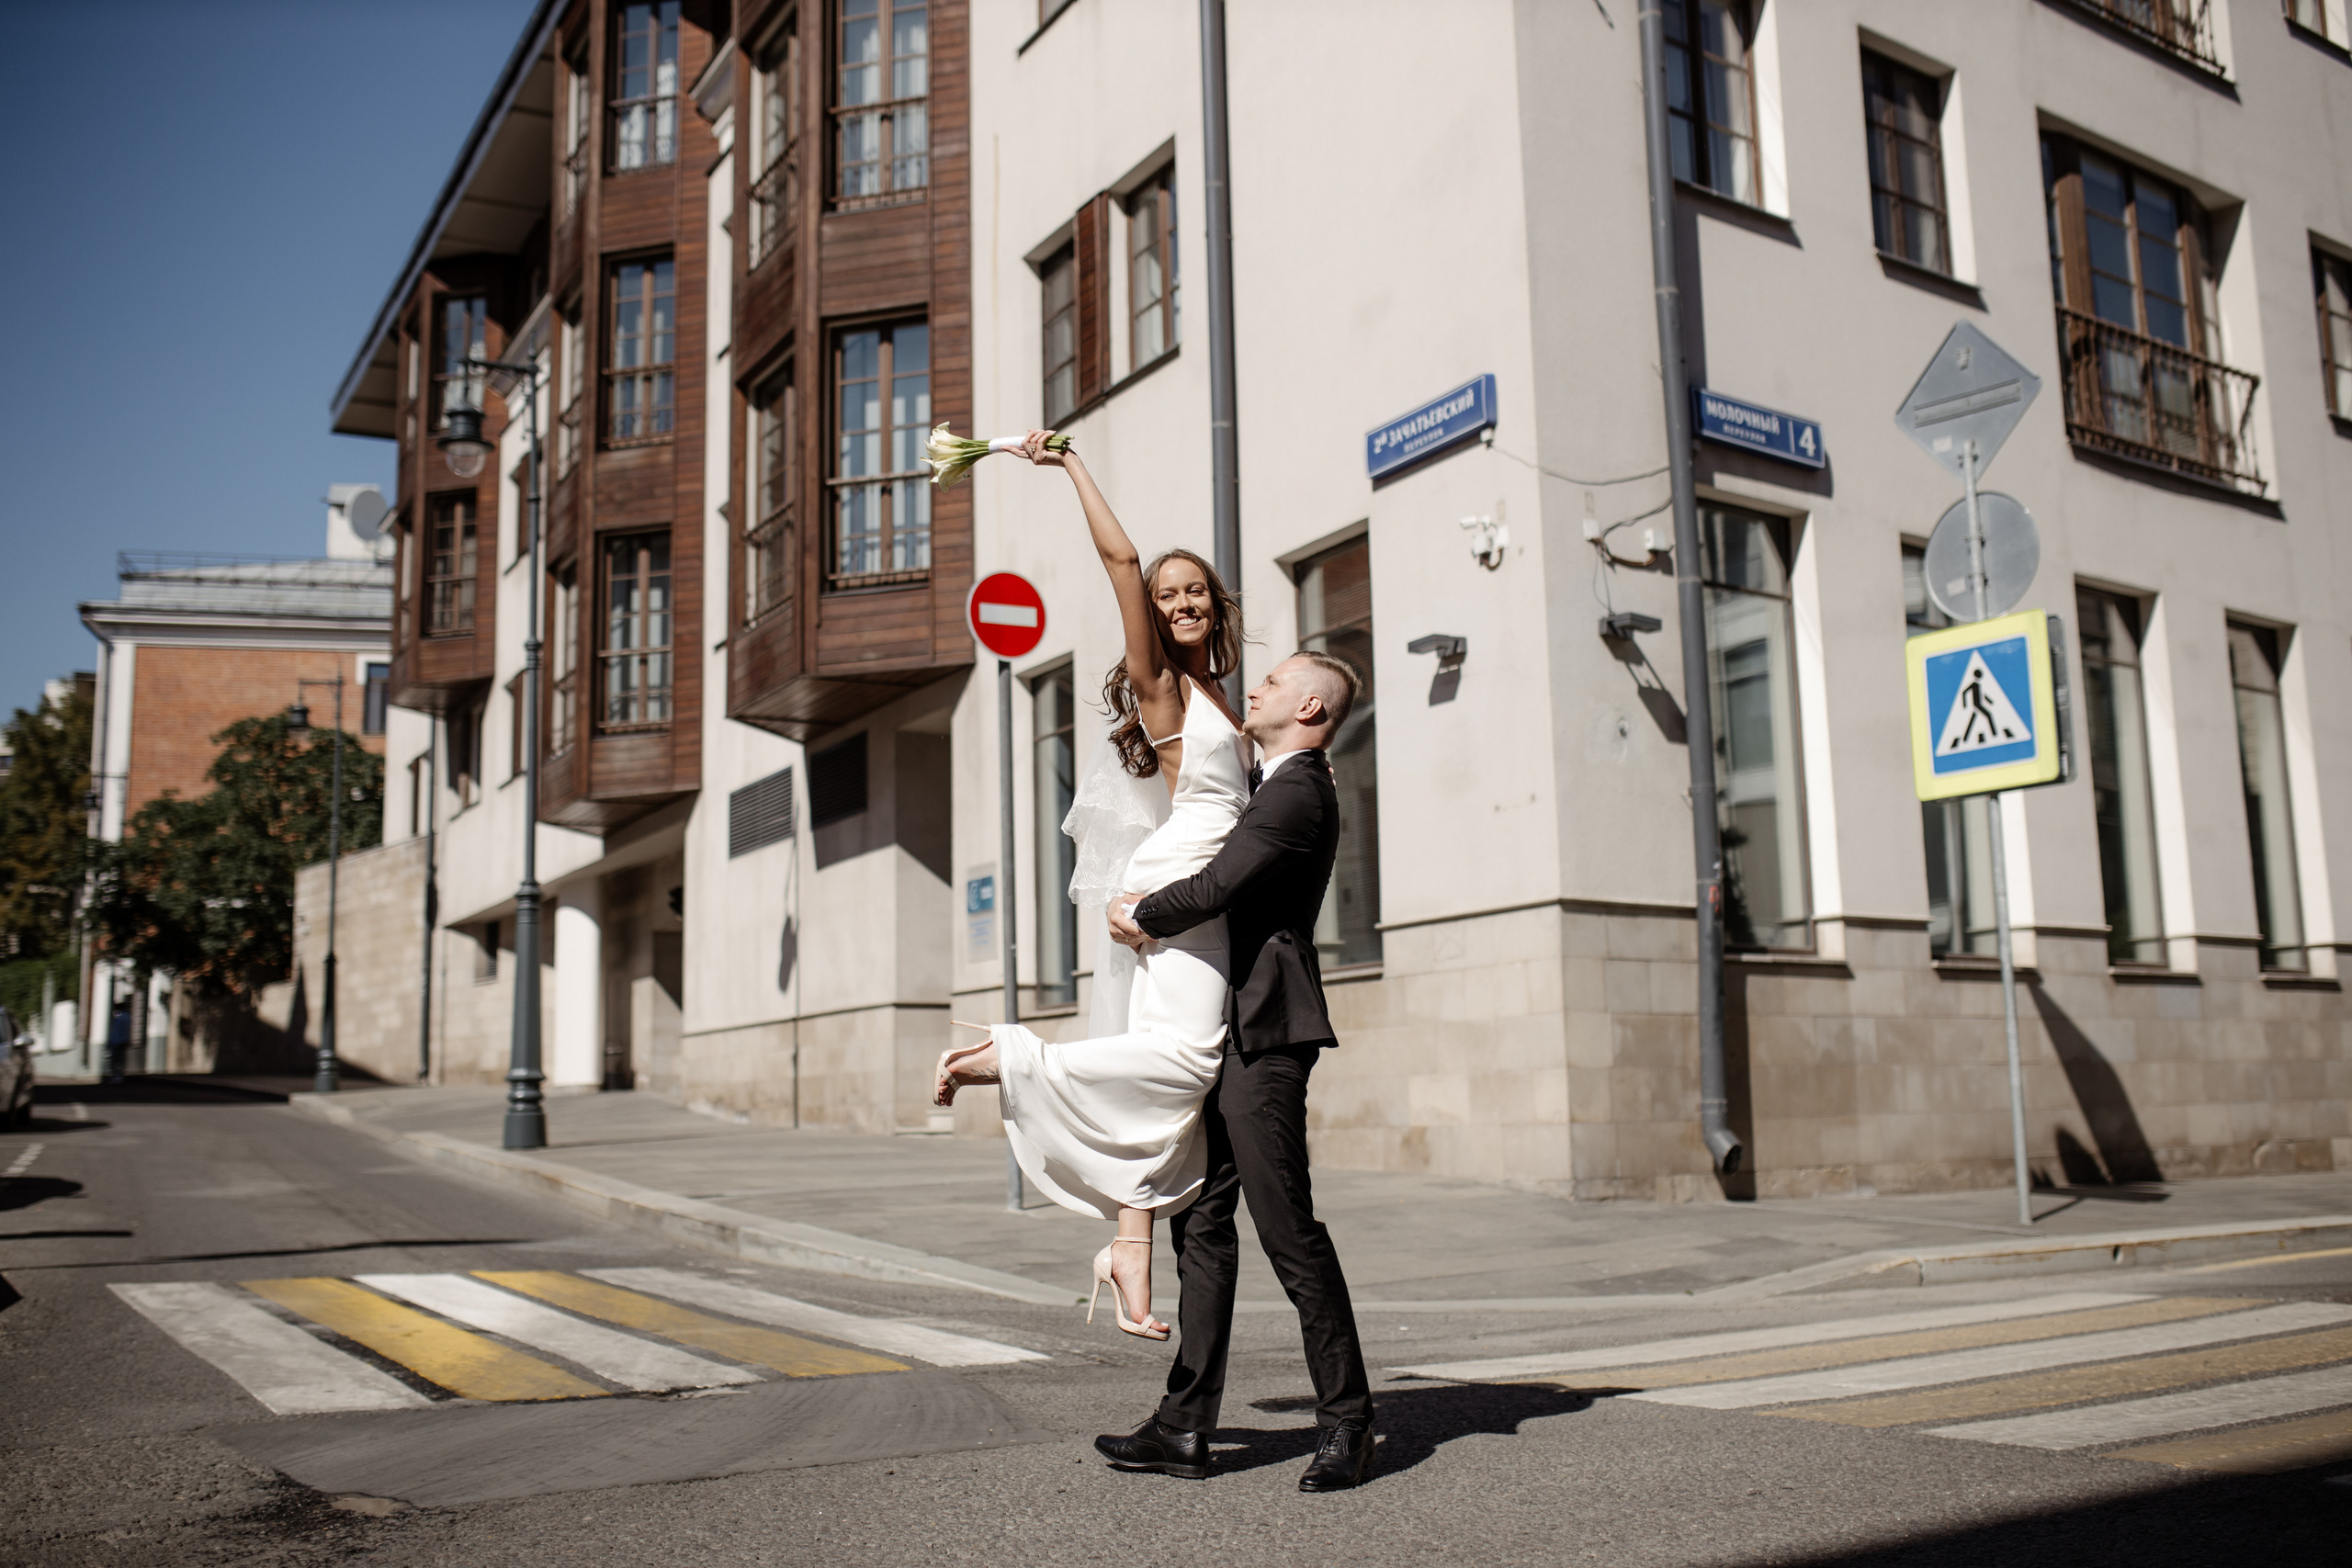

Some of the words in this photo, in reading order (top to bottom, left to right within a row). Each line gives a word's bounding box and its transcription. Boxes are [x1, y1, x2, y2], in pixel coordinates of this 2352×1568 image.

[1388, 388, 1475, 447] ЗАЧАТЬЕВСКИЙ
[1706, 399, 1780, 435] МОЛОЧНЫЙ
[1723, 423, 1767, 445] ПЕРЕУЛОК
[1799, 426, 1816, 457] 4
